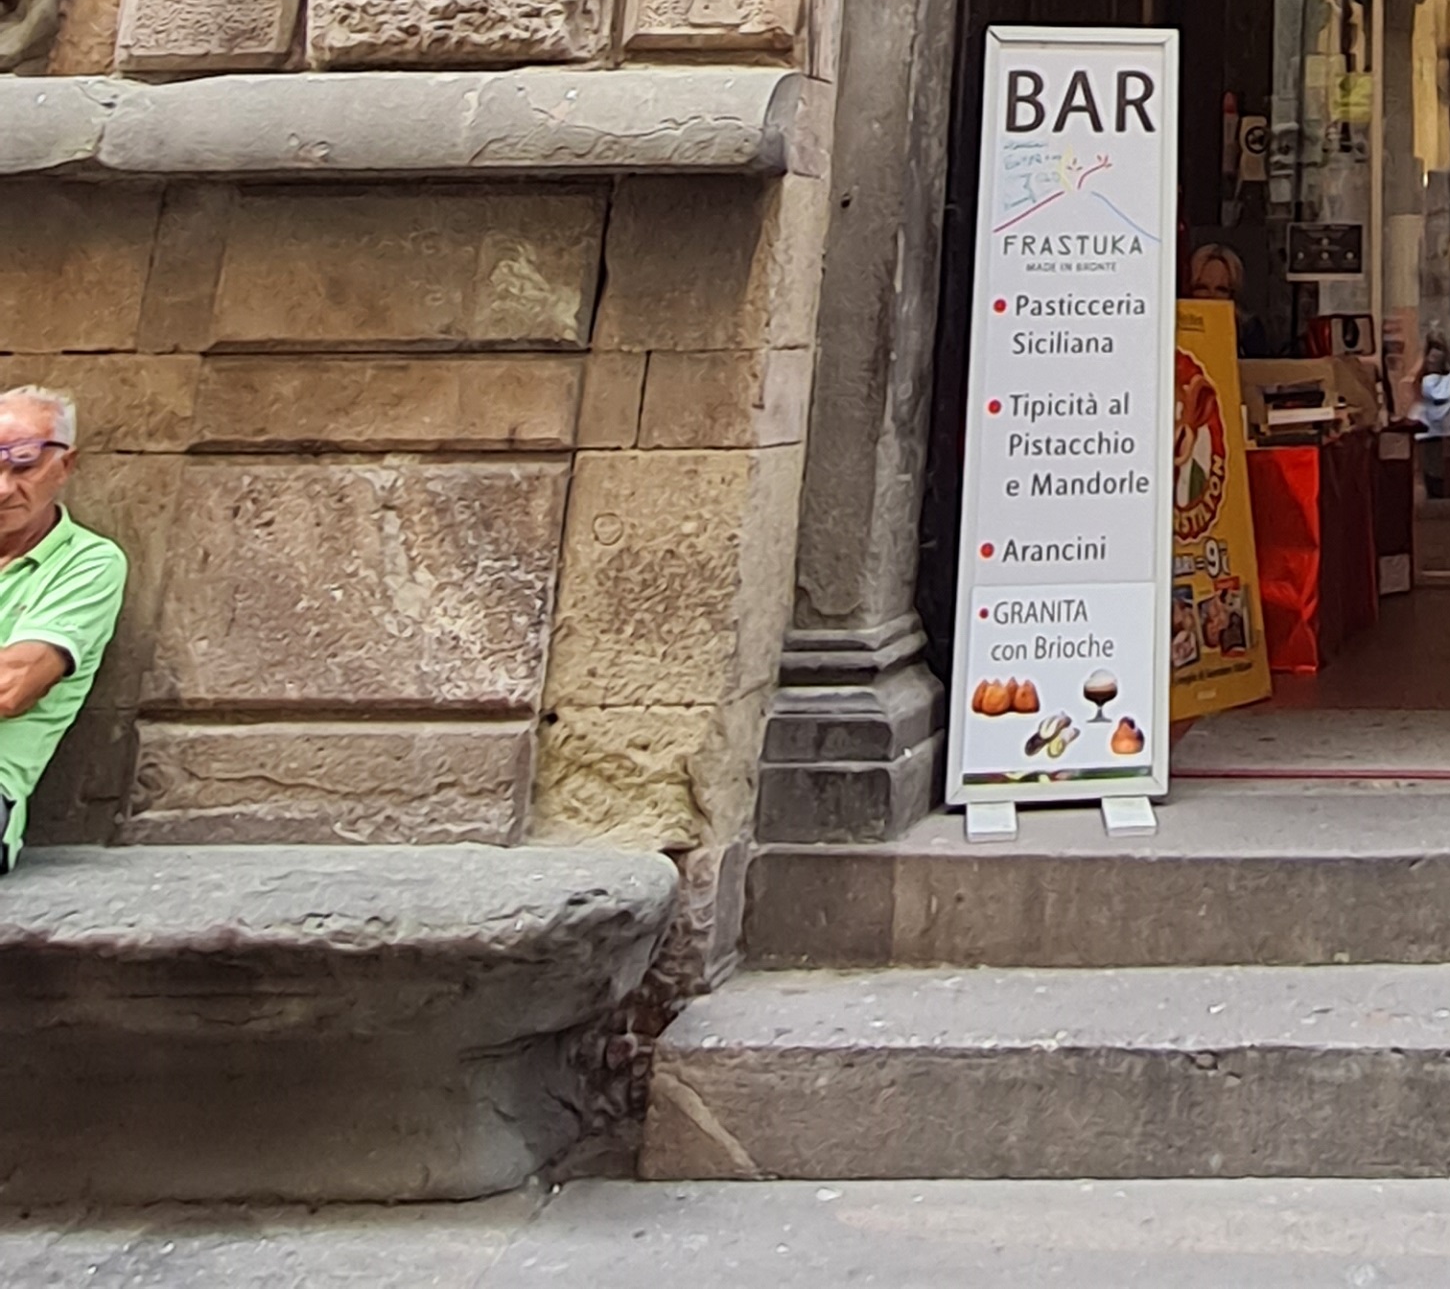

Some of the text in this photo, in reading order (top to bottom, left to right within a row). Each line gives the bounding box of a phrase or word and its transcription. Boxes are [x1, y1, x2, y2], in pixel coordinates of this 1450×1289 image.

[1004, 69, 1157, 134] BAR
[1003, 235, 1143, 256] FRASTUKA
[1026, 262, 1057, 272] MADE
[1060, 262, 1073, 271] IN
[1015, 292, 1146, 317] Pasticceria
[1012, 330, 1114, 355] Siciliana
[1009, 391, 1130, 424] Tipicità al
[1009, 430, 1136, 457] Pistacchio
[1006, 470, 1150, 497] e Mandorle
[1002, 535, 1107, 563] Arancini
[993, 599, 1089, 625] GRANITA
[990, 633, 1115, 662] con Brioche
